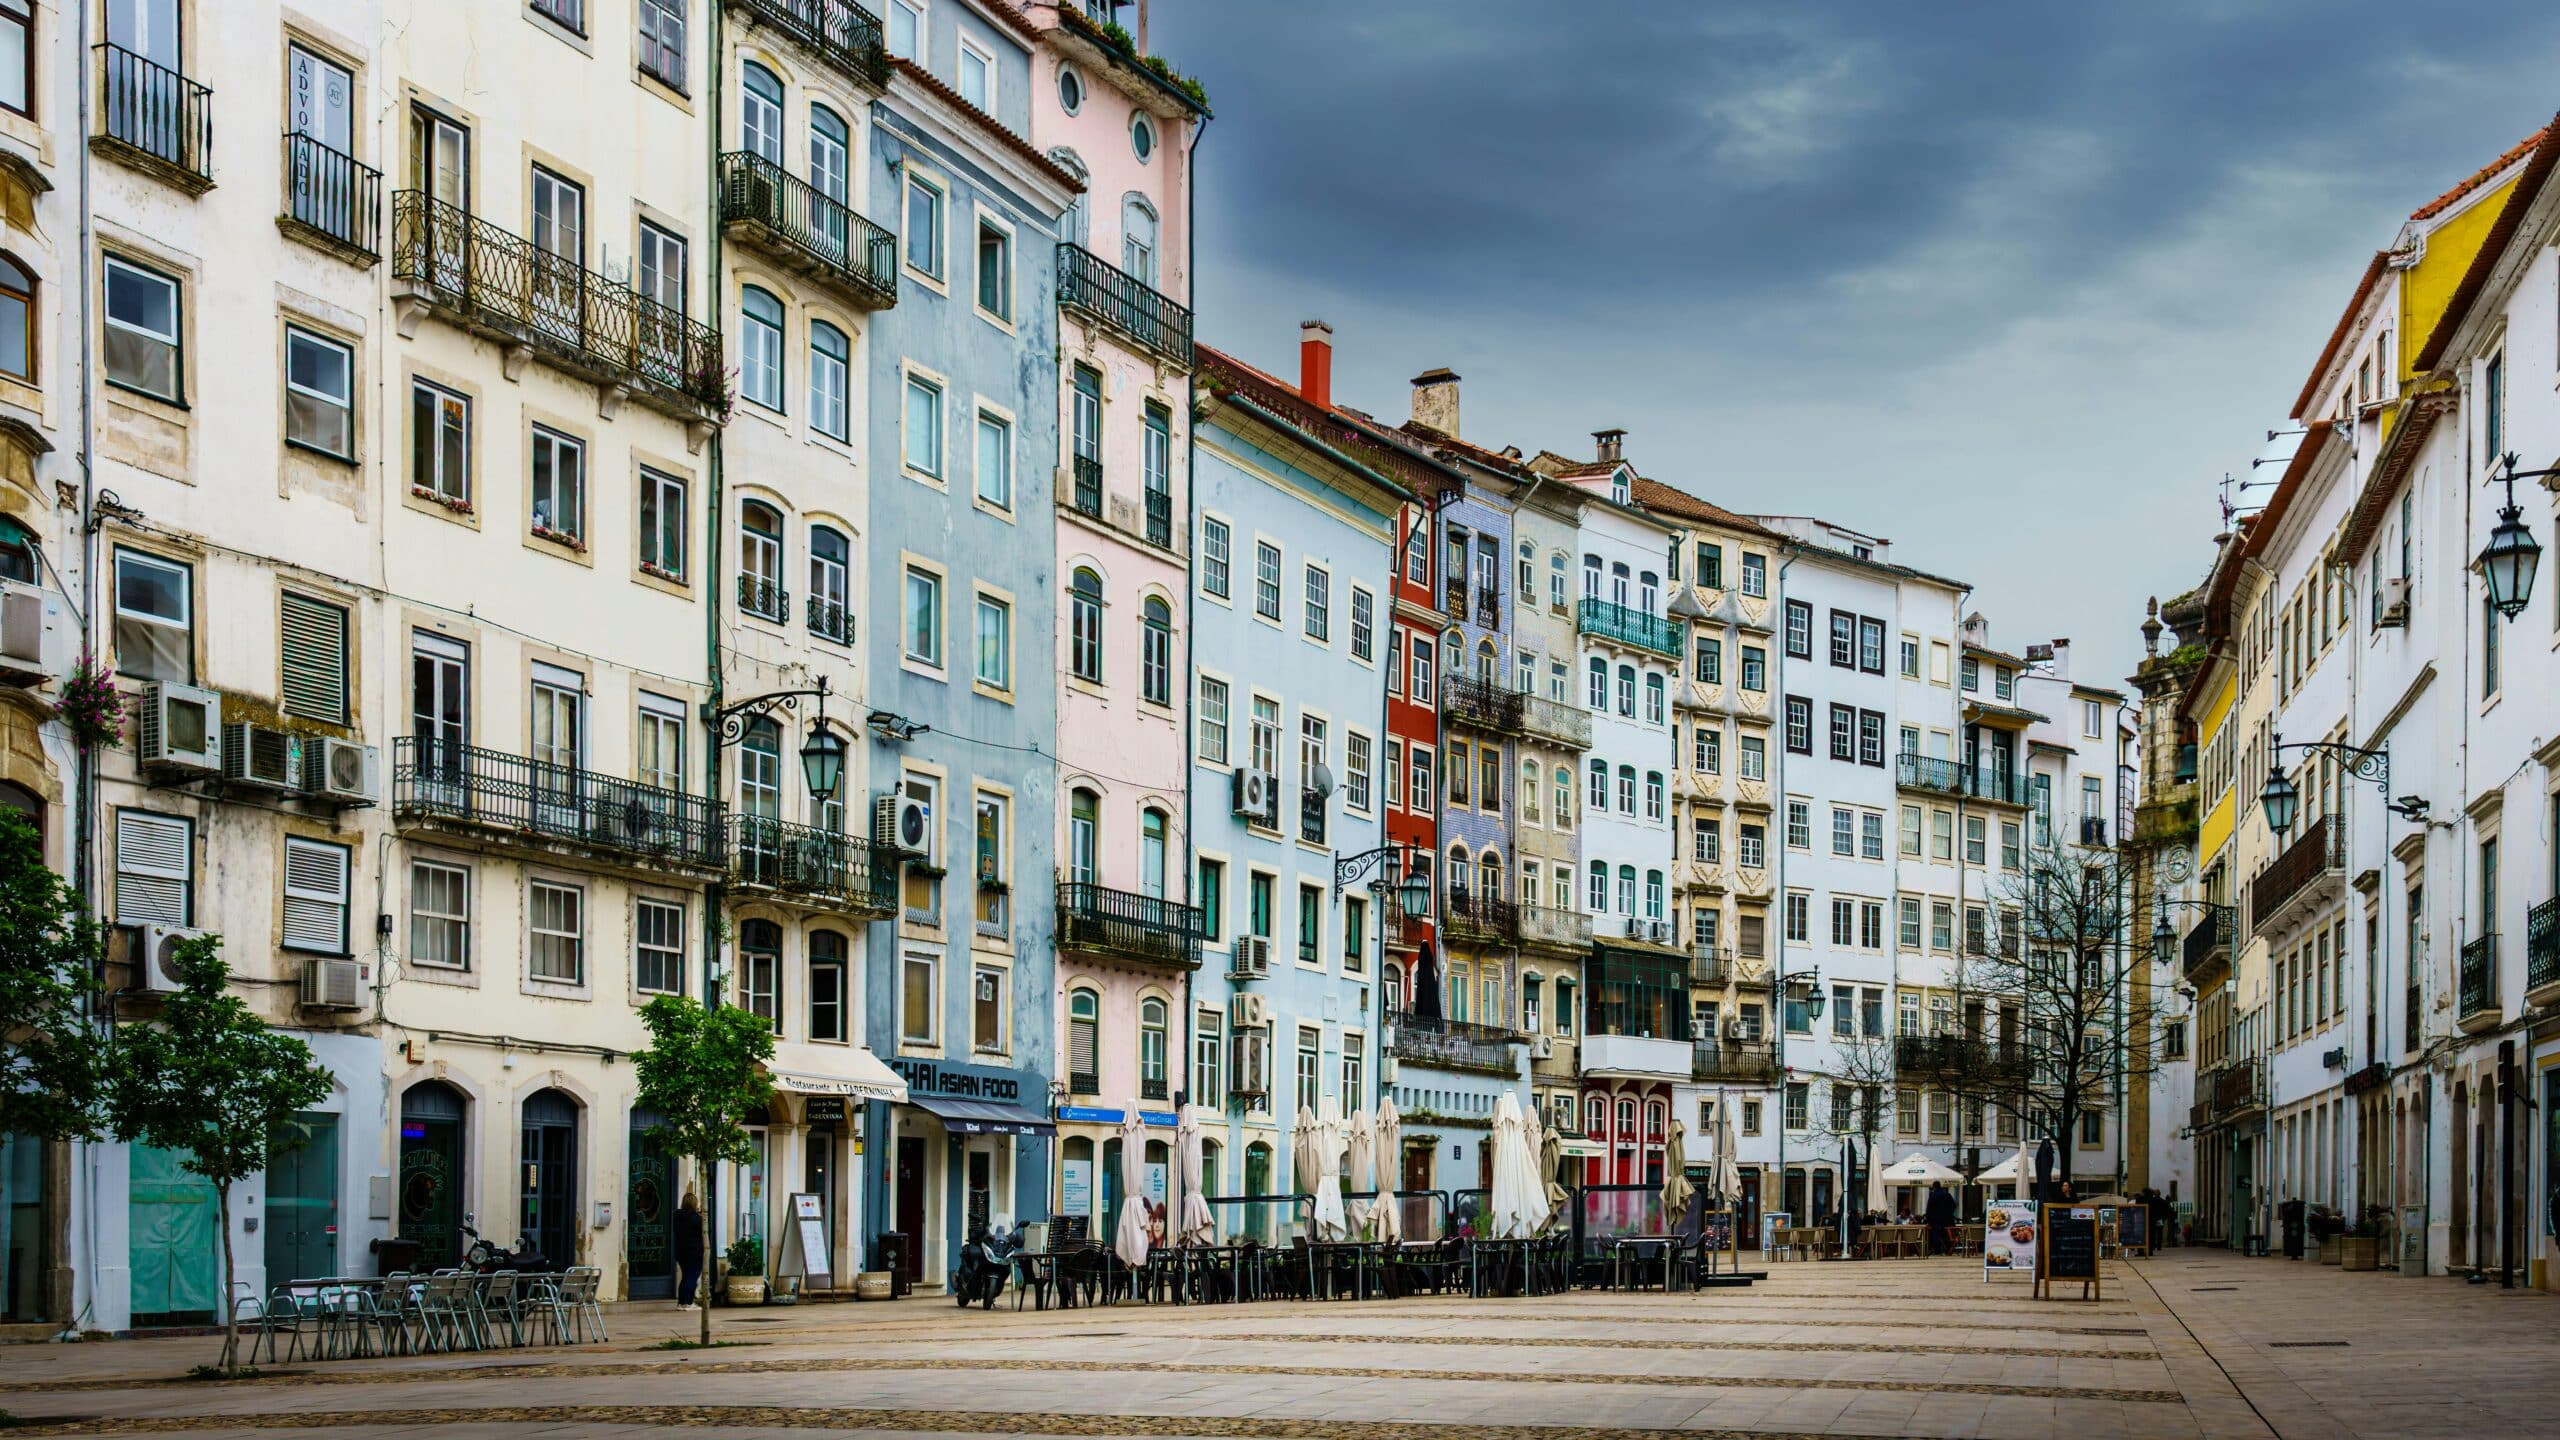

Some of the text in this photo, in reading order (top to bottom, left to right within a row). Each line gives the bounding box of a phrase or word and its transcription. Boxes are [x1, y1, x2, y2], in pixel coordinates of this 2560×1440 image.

[298, 58, 310, 197] ADVOGADO
[844, 1084, 897, 1099] TABERNINHA
[939, 1072, 980, 1097] ASIAN
[982, 1077, 1019, 1100] FOOD
